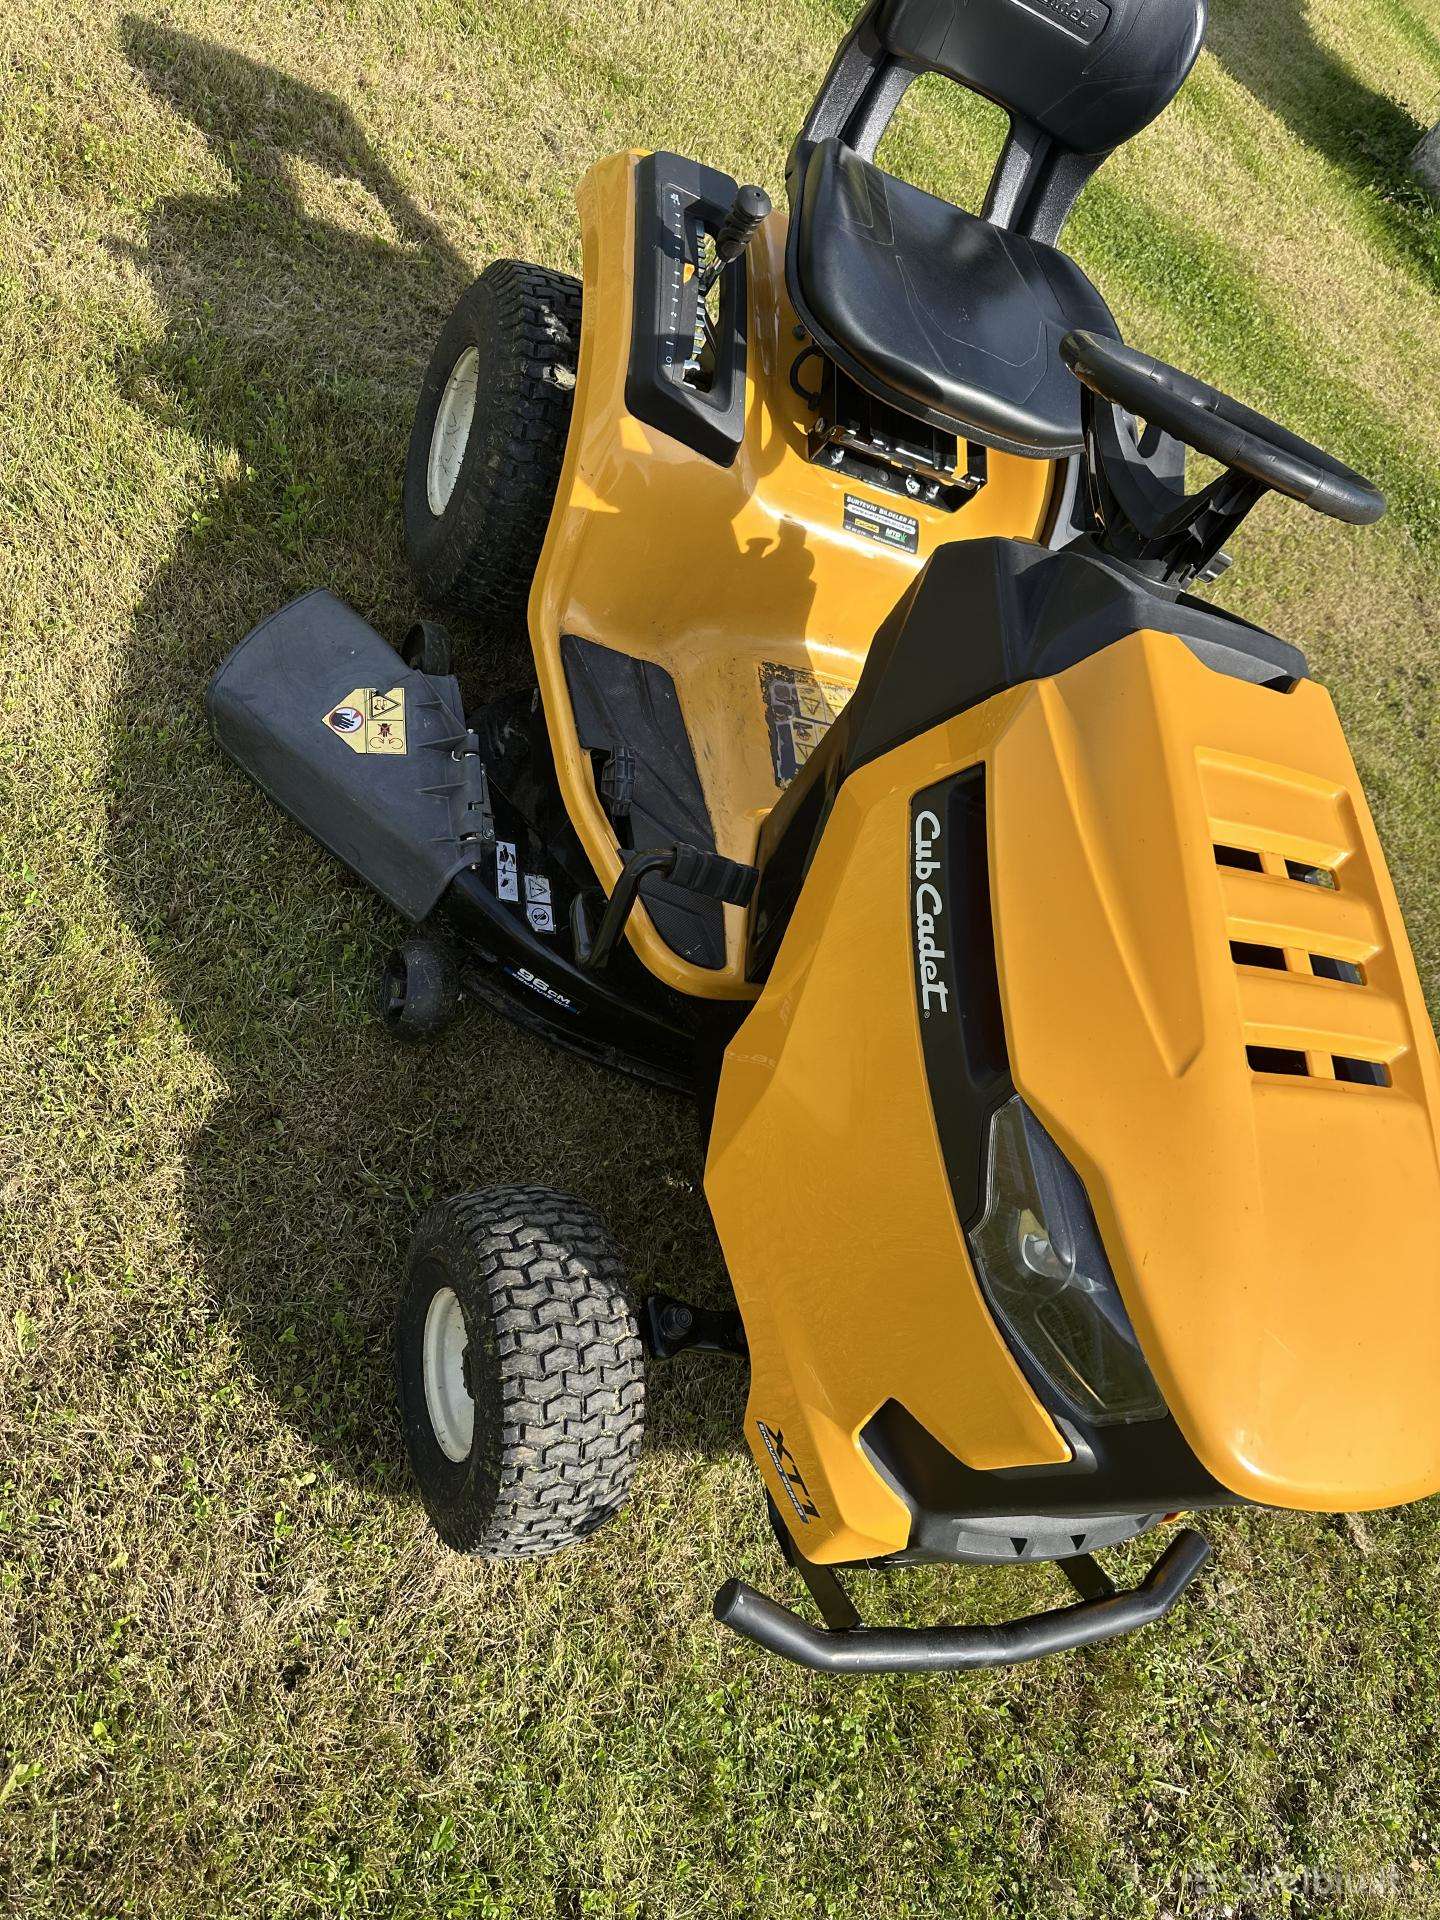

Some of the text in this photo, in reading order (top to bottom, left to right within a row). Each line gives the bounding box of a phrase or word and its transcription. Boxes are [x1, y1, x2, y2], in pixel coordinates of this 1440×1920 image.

[916, 811, 949, 1013] Cub Cadet
[759, 1423, 805, 1517] ENDURO SERIES
[765, 1423, 821, 1519] XT1
